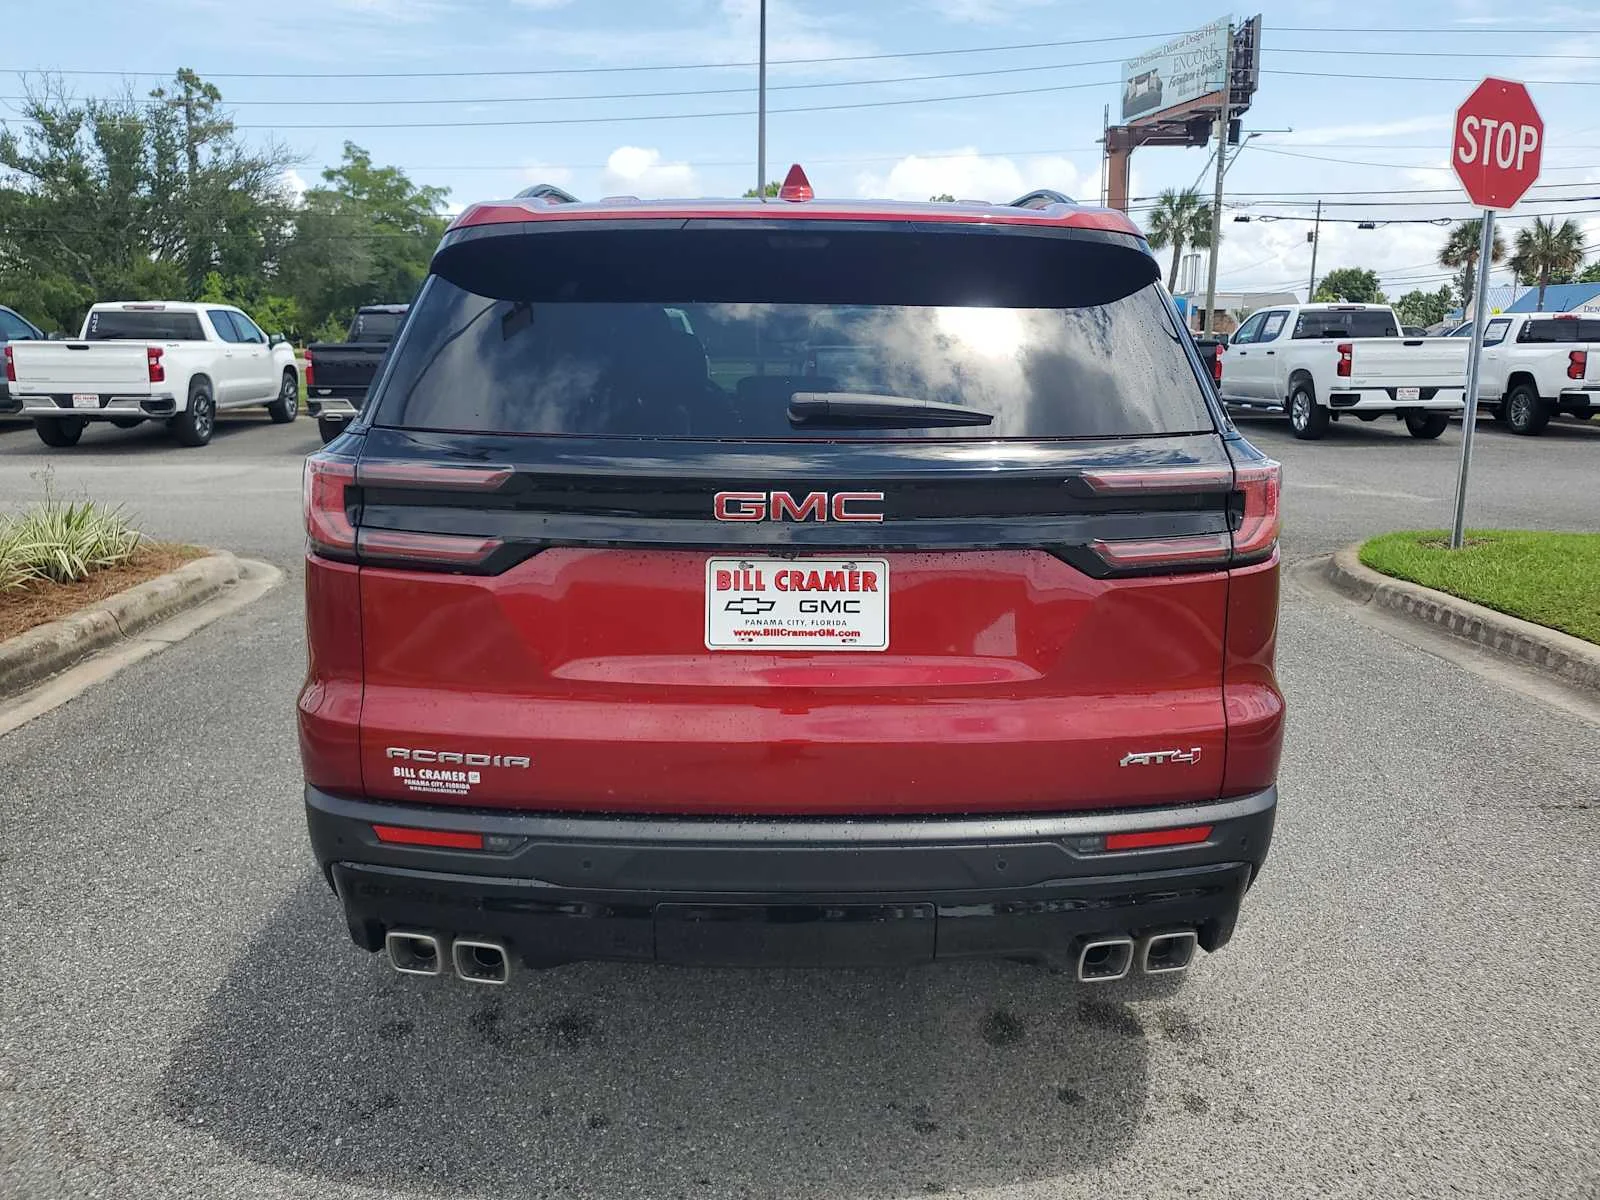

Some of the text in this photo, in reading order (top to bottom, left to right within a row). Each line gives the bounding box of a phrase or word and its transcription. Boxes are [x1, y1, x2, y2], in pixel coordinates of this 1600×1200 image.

[1458, 115, 1539, 171] STOP
[714, 491, 885, 522] GMC
[716, 569, 878, 593] BILL CRAMER
[799, 600, 861, 614] GMC
[787, 619, 807, 627] CITY,
[811, 619, 847, 627] FLORIDA
[733, 628, 861, 638] www.BillCramerGM.com
[386, 746, 531, 769] ACADIA
[1119, 747, 1201, 767] AT4
[393, 766, 416, 778] BILL
[419, 769, 466, 782] CRAMER
[404, 779, 430, 787] PANAMA
[445, 782, 470, 790] FLORIDA
